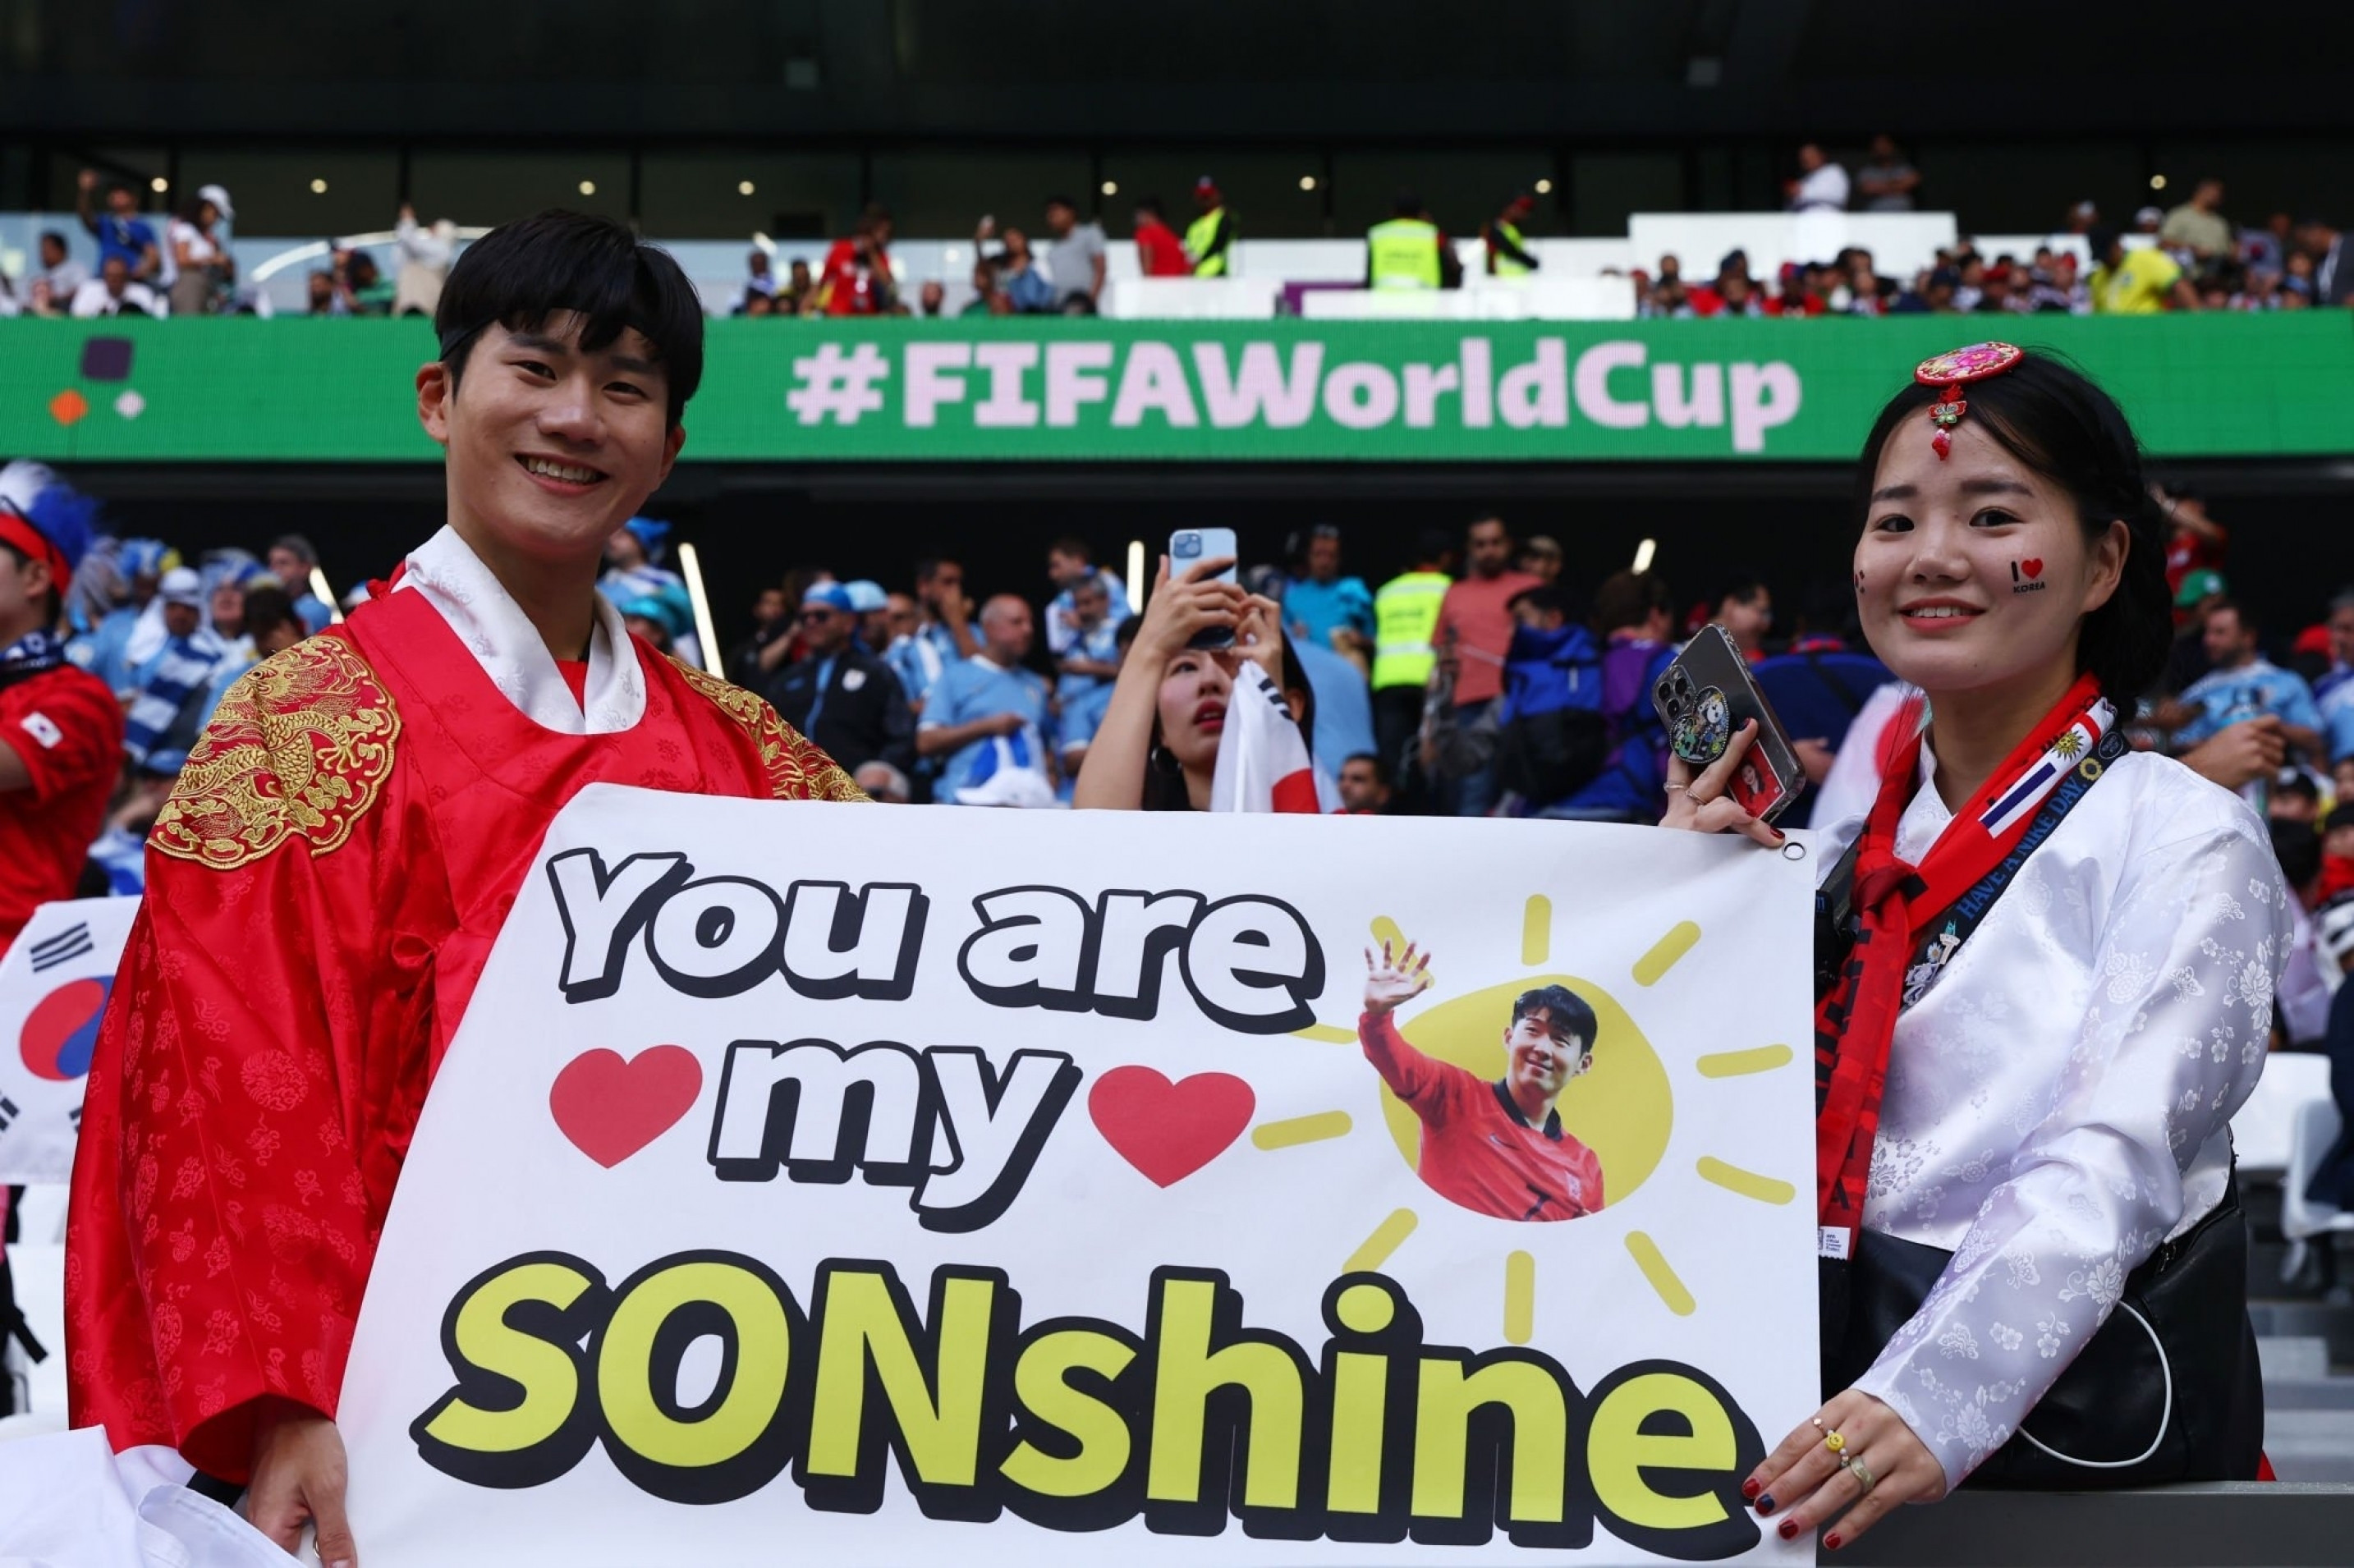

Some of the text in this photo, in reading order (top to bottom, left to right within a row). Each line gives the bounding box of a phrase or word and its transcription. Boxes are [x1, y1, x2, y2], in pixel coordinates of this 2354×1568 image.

[788, 339, 1801, 451] #FIFAWorldCup
[2011, 561, 2019, 582] I
[2013, 581, 2046, 594] KOREA
[546, 847, 1326, 1034] You are
[1956, 870, 2008, 919] HAVE
[2005, 856, 2021, 874] A
[706, 1038, 1083, 1234] my
[410, 1249, 1763, 1561] SONshine
